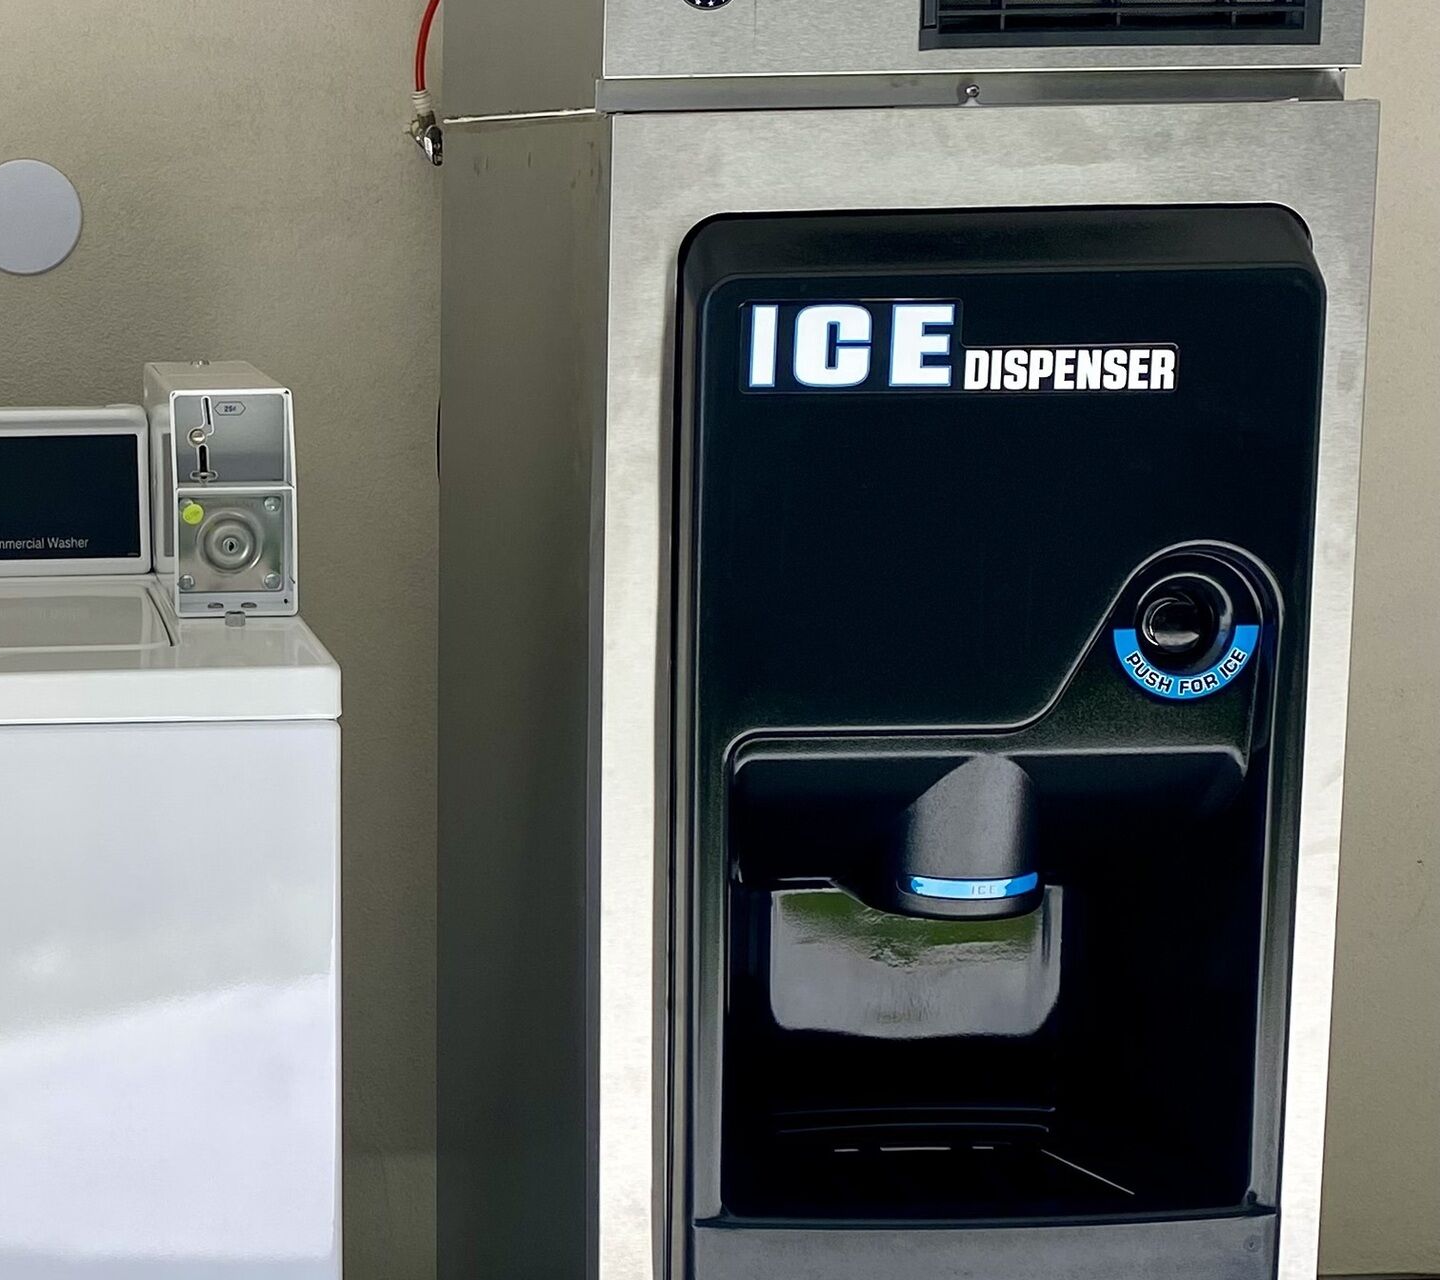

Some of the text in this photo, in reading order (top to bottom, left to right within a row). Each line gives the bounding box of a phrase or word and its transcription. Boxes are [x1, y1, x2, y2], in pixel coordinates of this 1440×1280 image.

[748, 303, 1176, 390] ICE DISPENSER
[47, 536, 89, 549] Washer
[1125, 647, 1247, 696] PUSH FOR ICE
[971, 885, 997, 895] ICE
